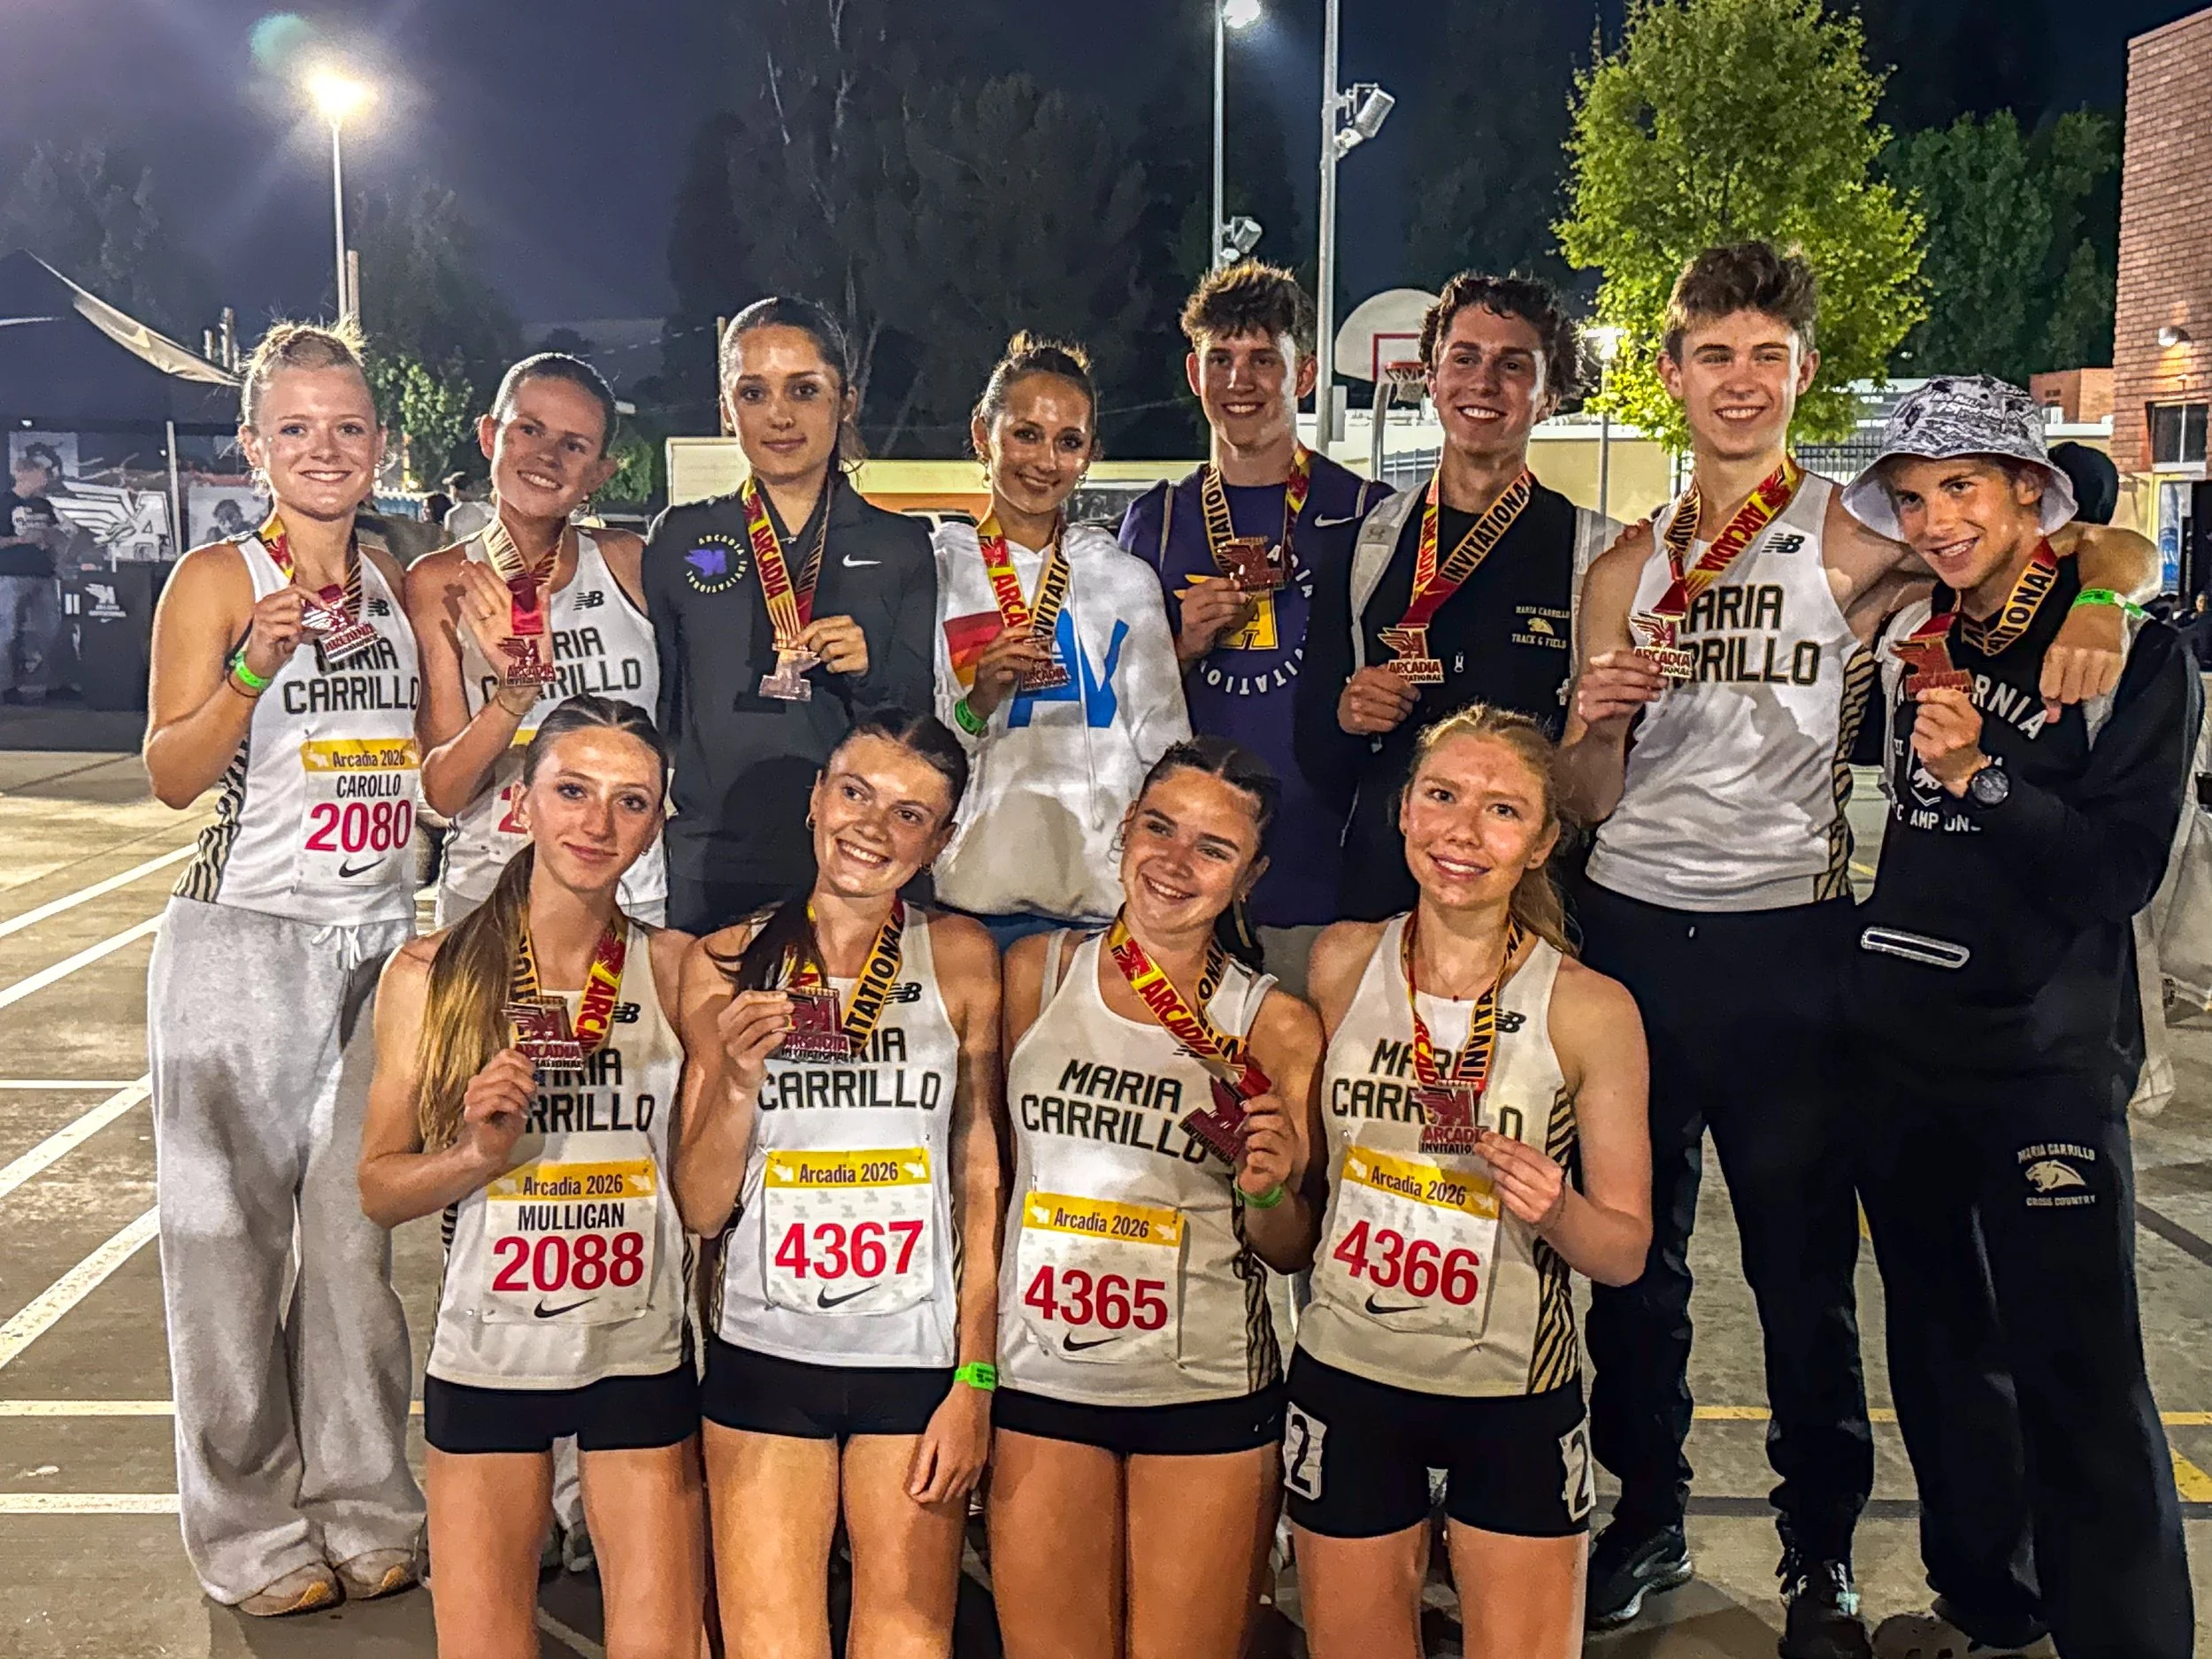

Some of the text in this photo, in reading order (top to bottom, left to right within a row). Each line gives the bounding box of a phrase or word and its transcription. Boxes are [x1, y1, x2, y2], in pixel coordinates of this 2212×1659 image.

[698, 534, 745, 556] ARCADIA
[1695, 503, 1769, 572] ARCADIA
[686, 560, 748, 594] INVITATIONAL
[752, 524, 789, 600] ARCADIA
[1516, 605, 1571, 619] MARIA CARRILLO
[1681, 584, 1784, 634] ARIA
[552, 626, 606, 660] RIA
[1511, 634, 1535, 645] TRACK
[1545, 638, 1567, 649] FIELD
[1388, 660, 1440, 674] ARCADIA
[333, 749, 405, 767] Arcadia 2026
[336, 774, 402, 798] CAROLLO
[304, 800, 412, 852] 2080
[1138, 977, 1218, 1056] ARCADIA
[757, 1070, 941, 1110] CARRILLO
[1058, 1059, 1183, 1114] MARIA
[526, 1094, 655, 1133] RRILLO
[799, 1162, 898, 1184] Arcadia 2026
[2017, 1143, 2095, 1164] MARIA CARRILLO
[523, 1174, 624, 1196] Arcadia 2026
[1371, 1165, 1467, 1206] Arcadia 2026
[2026, 1194, 2096, 1206] CROSS COUNTRY
[518, 1202, 625, 1232] MULLIGAN
[1054, 1207, 1149, 1239] Arcadia 2026
[492, 1232, 644, 1292] 2088
[775, 1219, 924, 1279] 4367
[1333, 1220, 1479, 1306] 4366
[1025, 1264, 1169, 1331] 4365
[1291, 1413, 1312, 1493] 2
[1571, 1430, 1589, 1512] 2
